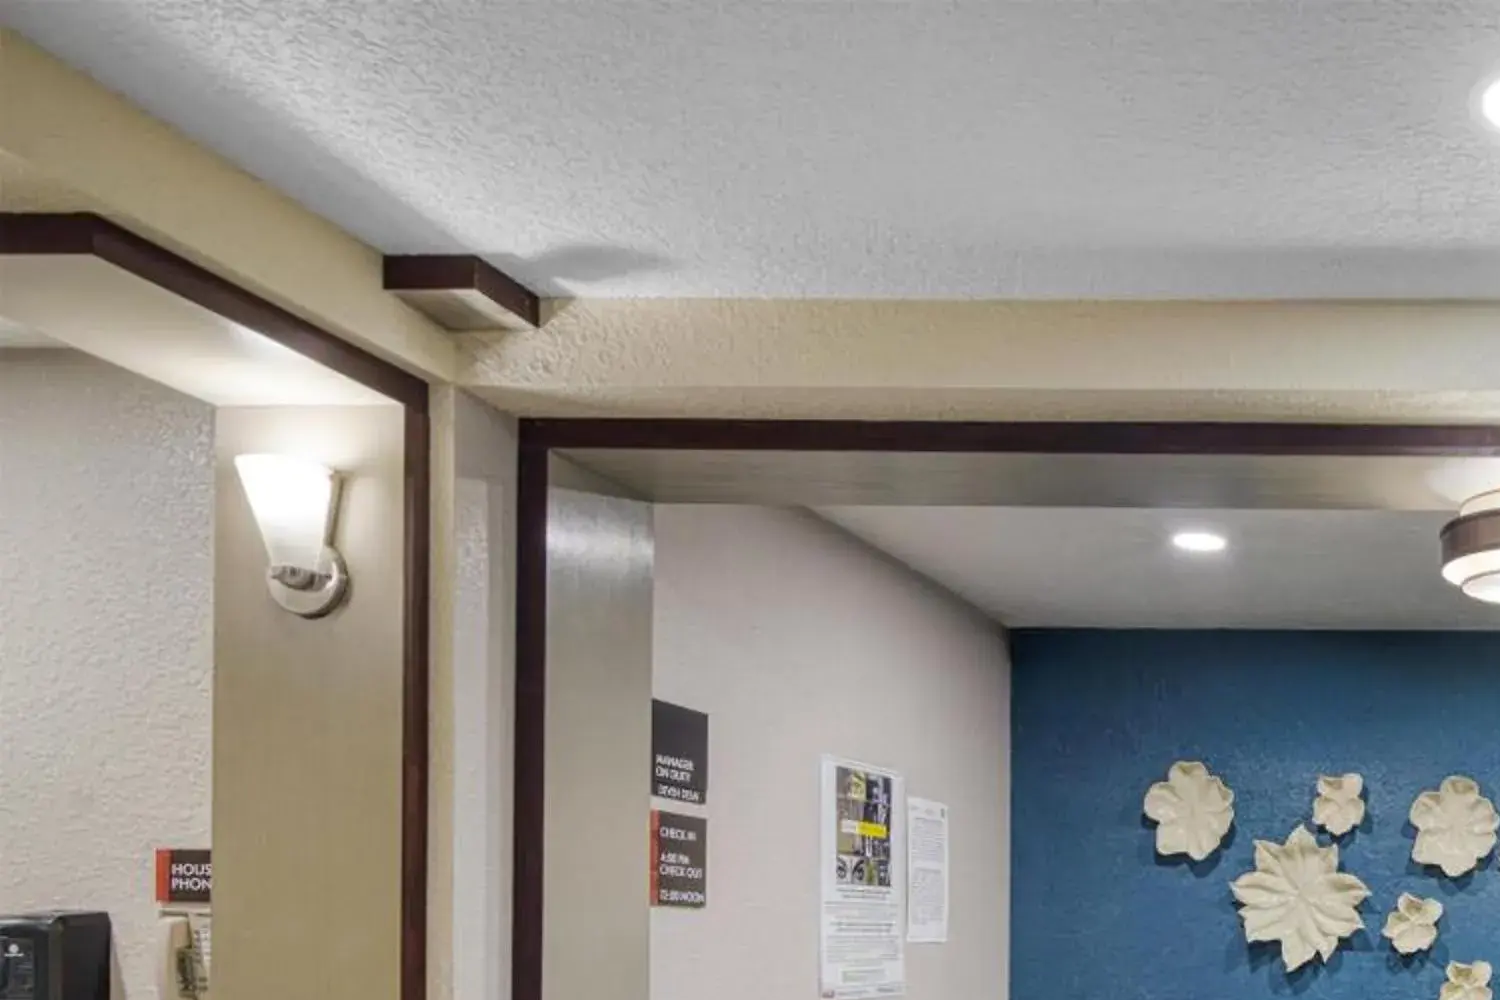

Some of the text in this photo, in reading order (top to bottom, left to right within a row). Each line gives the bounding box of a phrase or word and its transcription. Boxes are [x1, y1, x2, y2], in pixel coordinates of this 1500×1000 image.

[660, 826, 686, 840] CHECK
[171, 863, 212, 876] HOUS
[660, 863, 703, 879] CHECK OUT
[171, 877, 212, 891] PHON
